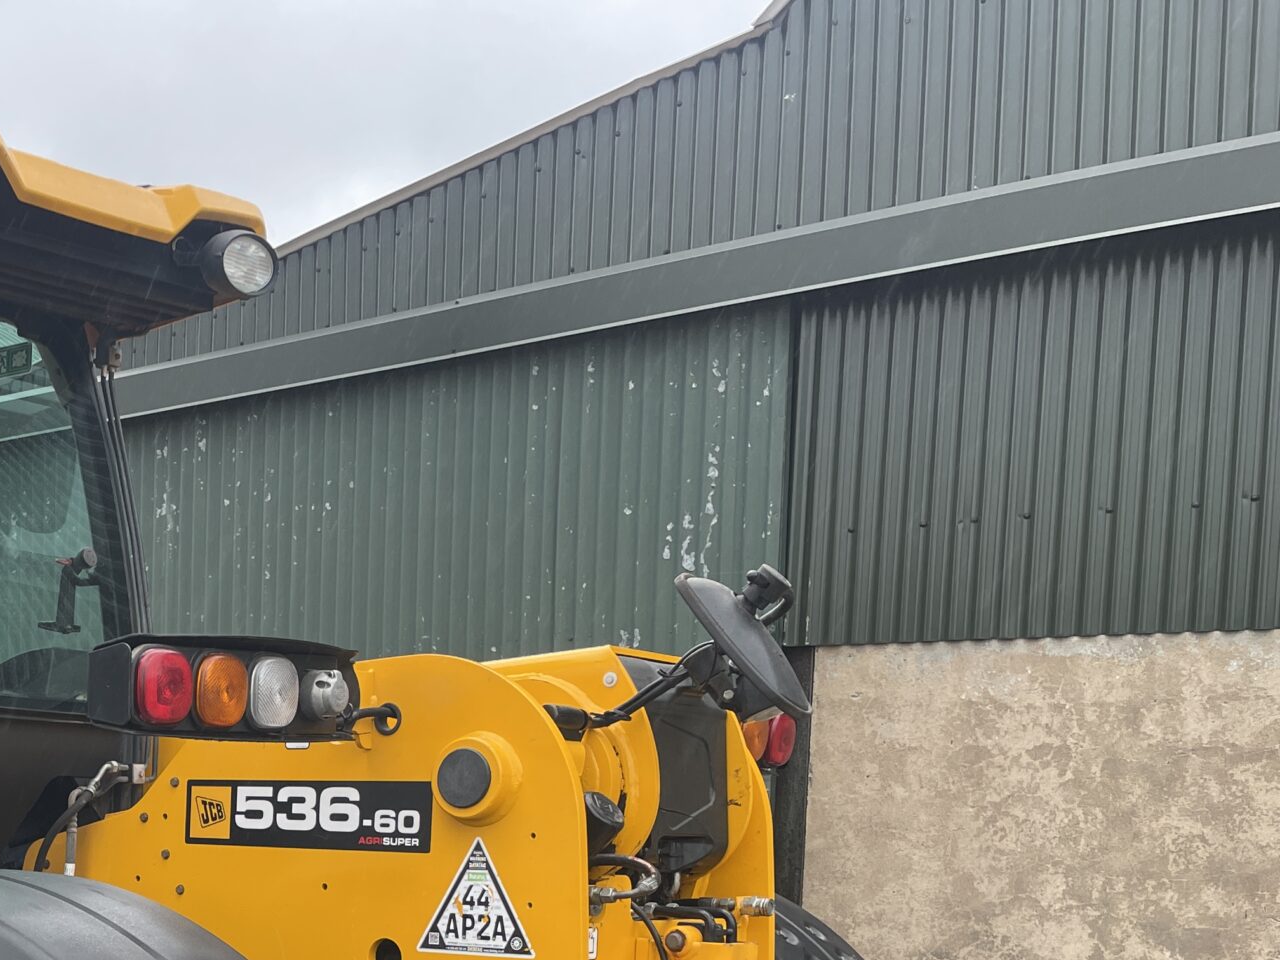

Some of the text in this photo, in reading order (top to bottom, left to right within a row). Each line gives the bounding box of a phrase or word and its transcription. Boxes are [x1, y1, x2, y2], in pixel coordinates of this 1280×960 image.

[201, 799, 225, 825] JCB
[234, 786, 420, 833] 536-60
[462, 884, 490, 912] 44
[445, 912, 507, 942] AP2A
